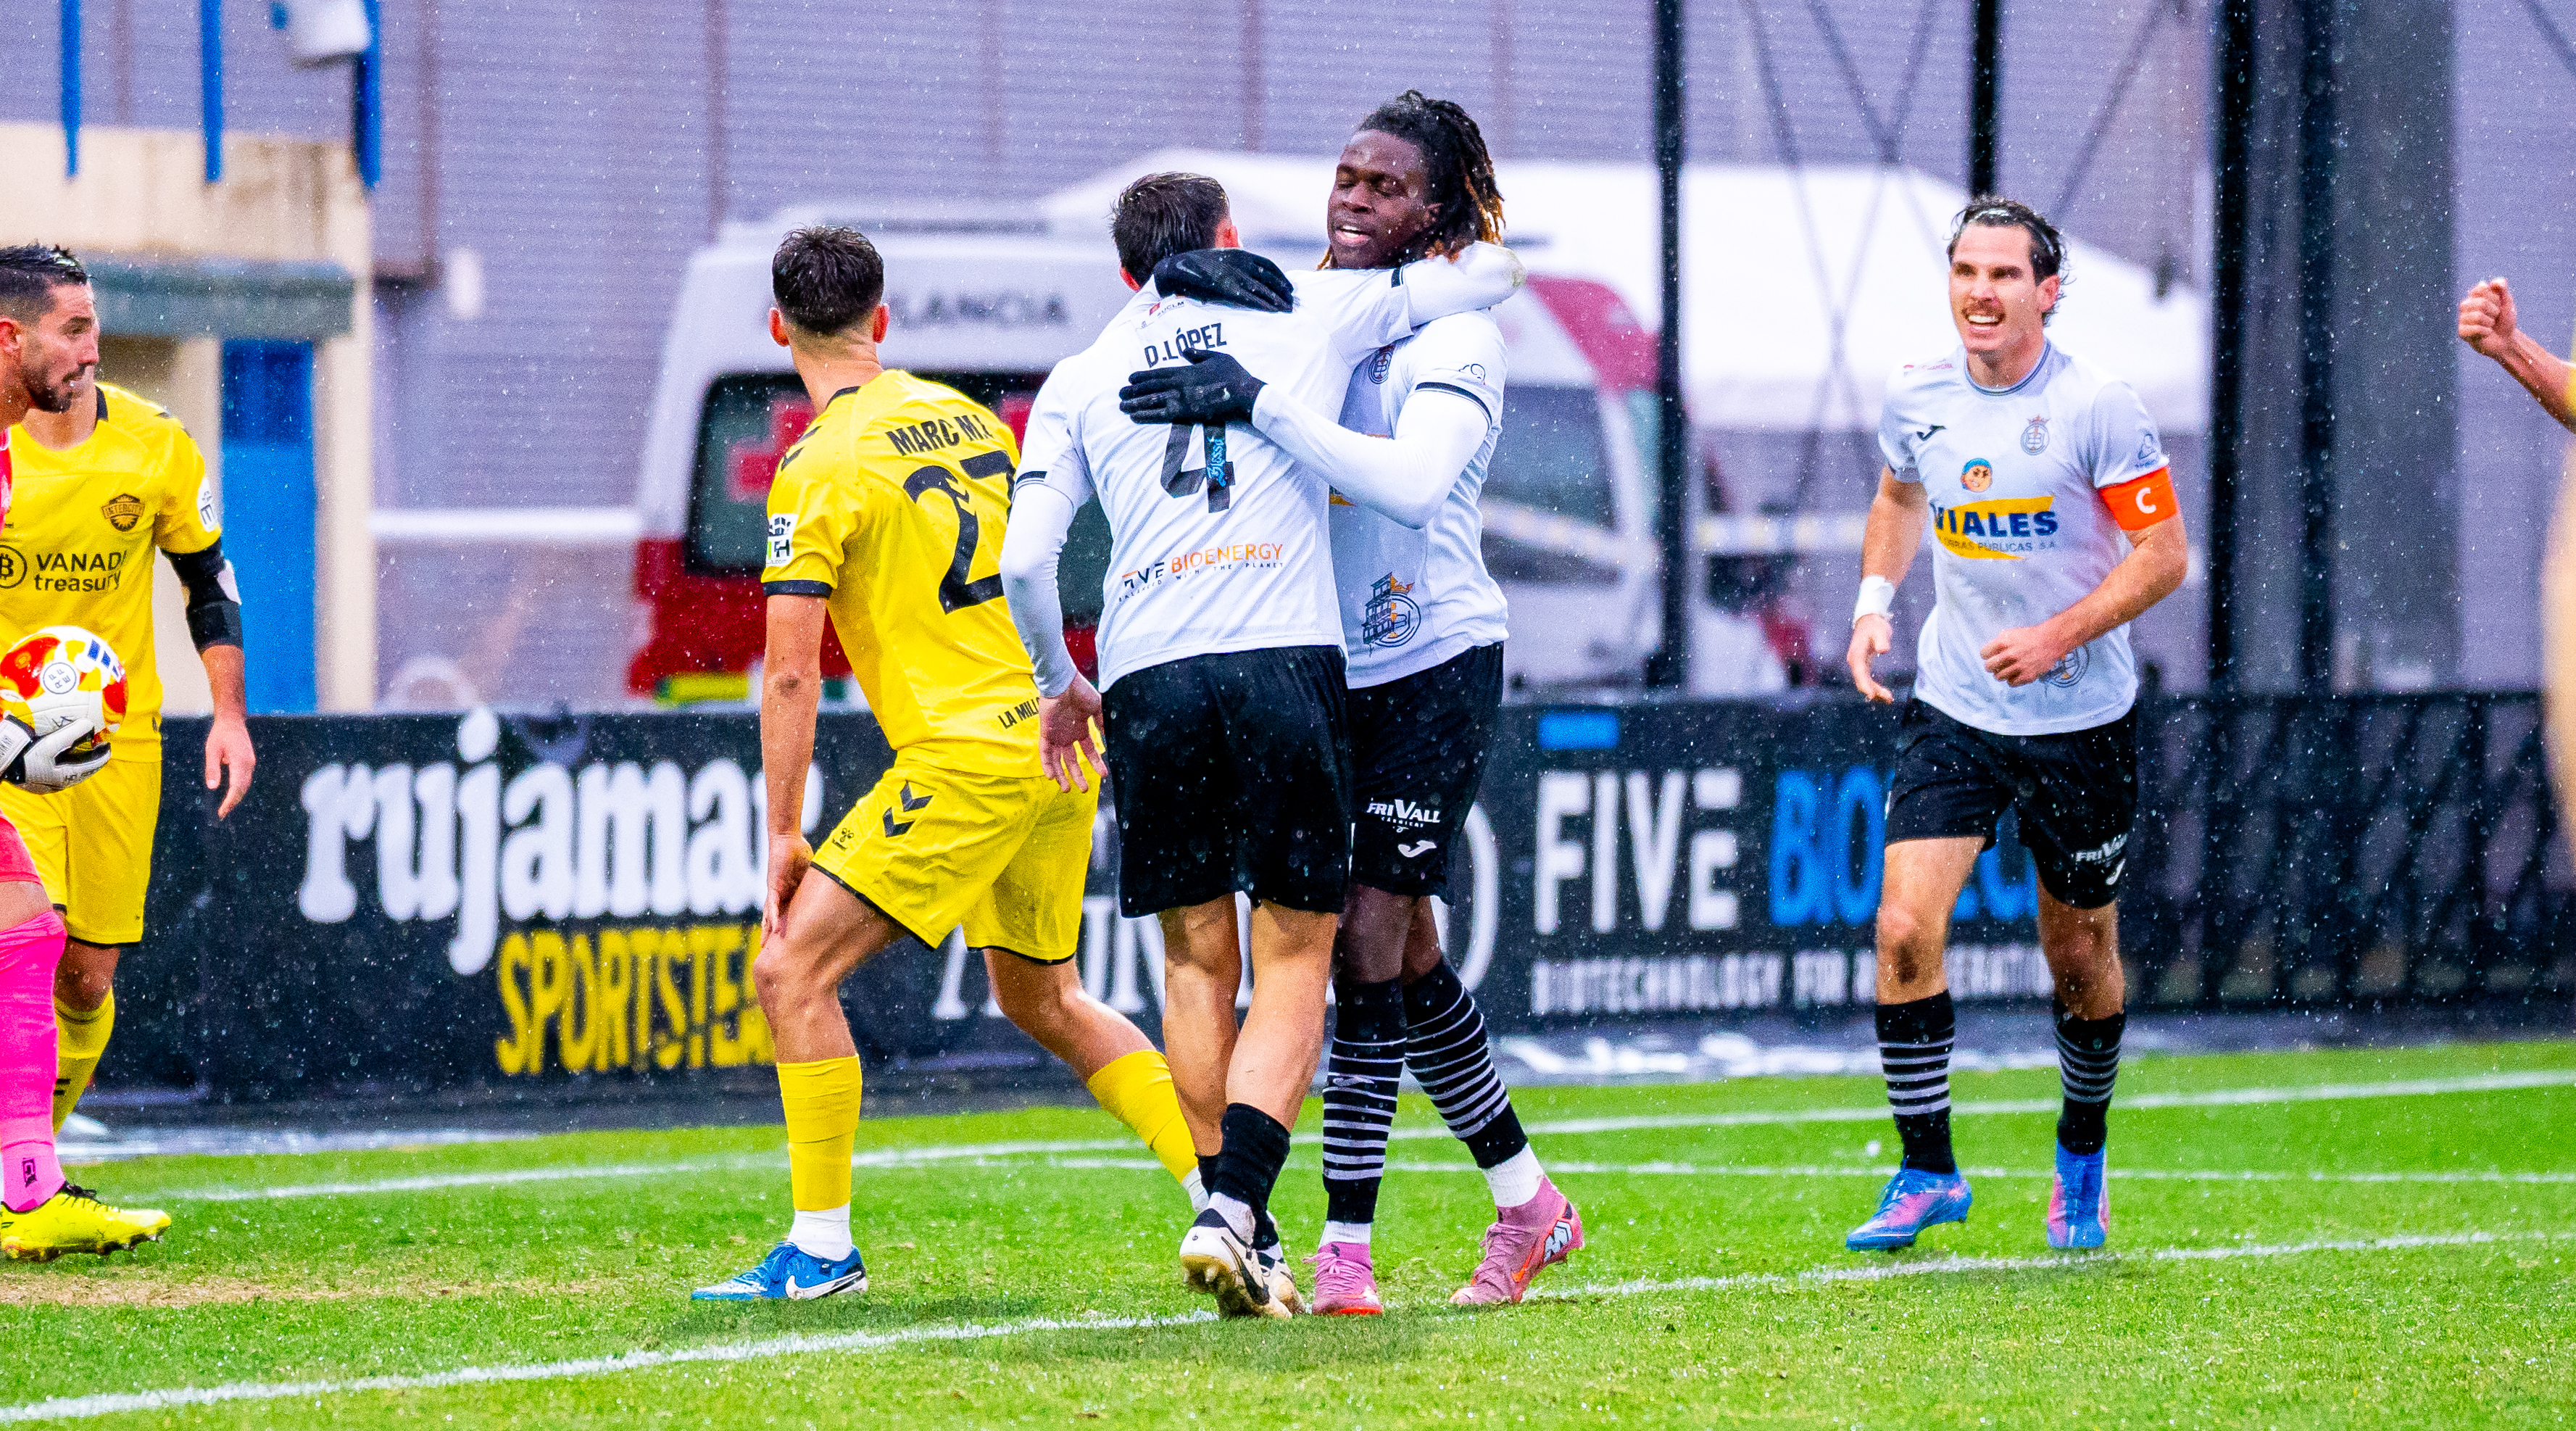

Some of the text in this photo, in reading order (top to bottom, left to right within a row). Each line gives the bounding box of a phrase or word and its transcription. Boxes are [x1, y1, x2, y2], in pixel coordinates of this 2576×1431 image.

[1144, 323, 1227, 368] D.LÓPEZ
[885, 419, 960, 456] MARC
[2135, 487, 2157, 514] C
[903, 449, 1016, 615] 27
[1929, 502, 2058, 538] VIALES
[1171, 543, 1283, 574] BIOENERGY
[34, 571, 122, 592] treasury
[997, 710, 1018, 729] LA
[1532, 767, 1741, 936] FIVE
